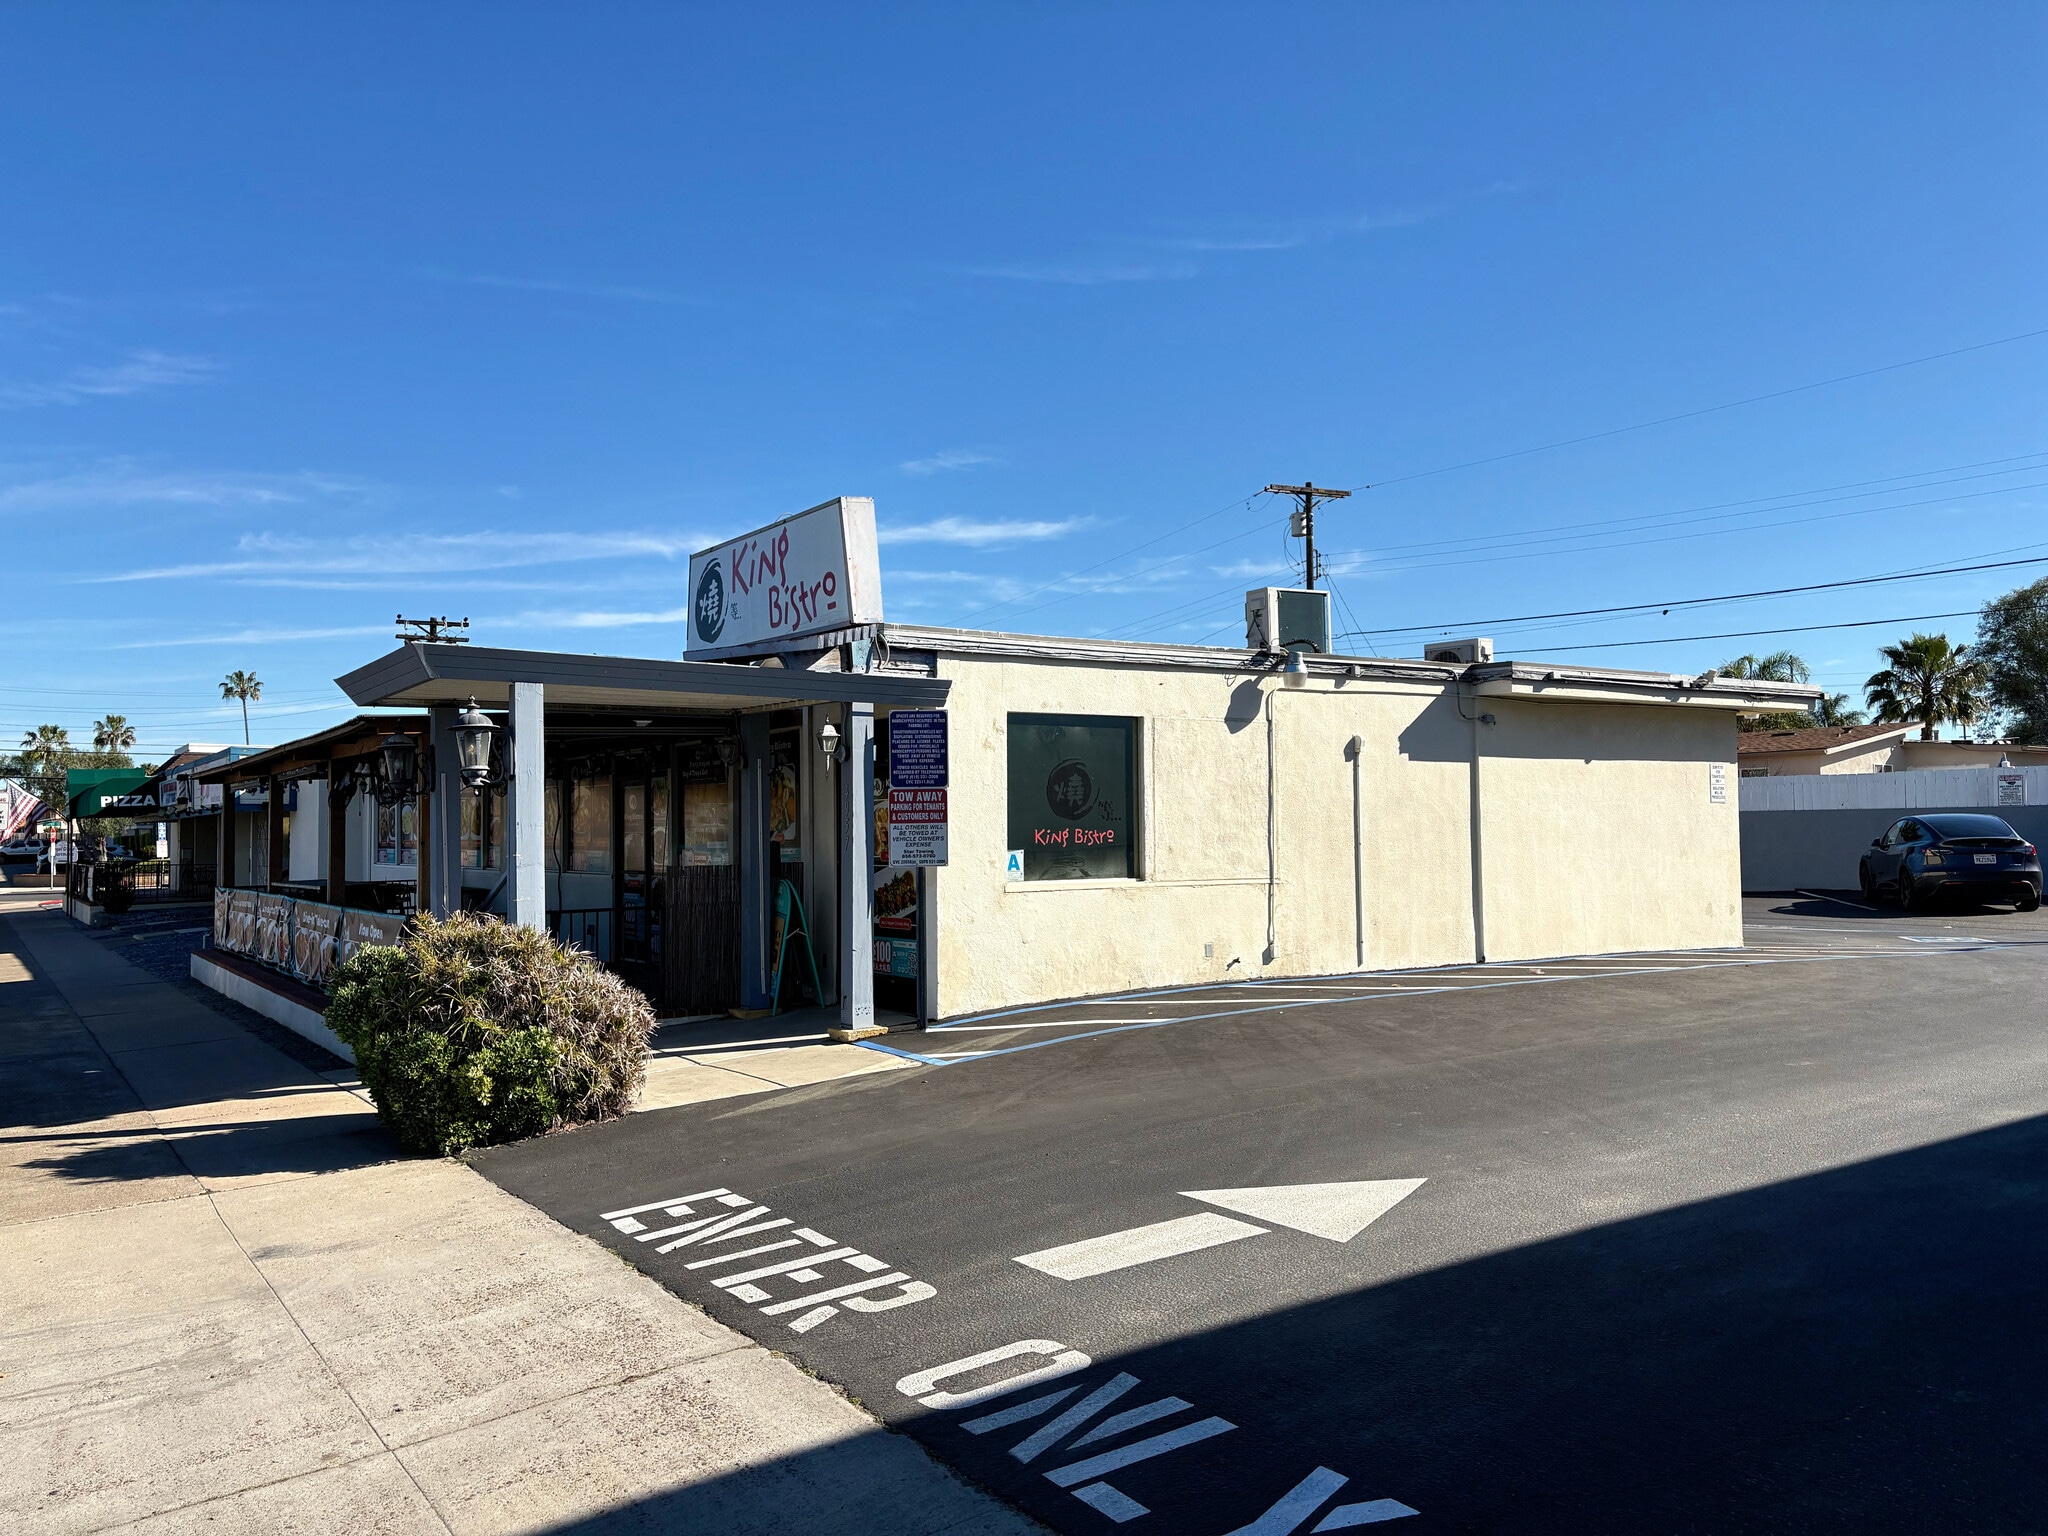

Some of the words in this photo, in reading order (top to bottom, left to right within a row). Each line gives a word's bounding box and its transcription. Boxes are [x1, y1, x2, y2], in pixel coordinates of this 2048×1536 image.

[731, 526, 789, 596] King
[768, 571, 837, 631] Bistro
[101, 795, 156, 808] PIZZA
[893, 792, 913, 802] TOW
[917, 792, 943, 801] AWAY
[1034, 828, 1069, 848] King
[1074, 828, 1115, 846] Bistro
[1008, 854, 1020, 870] A
[600, 1186, 938, 1334] ENTER
[896, 1338, 1421, 1536] ONLY
